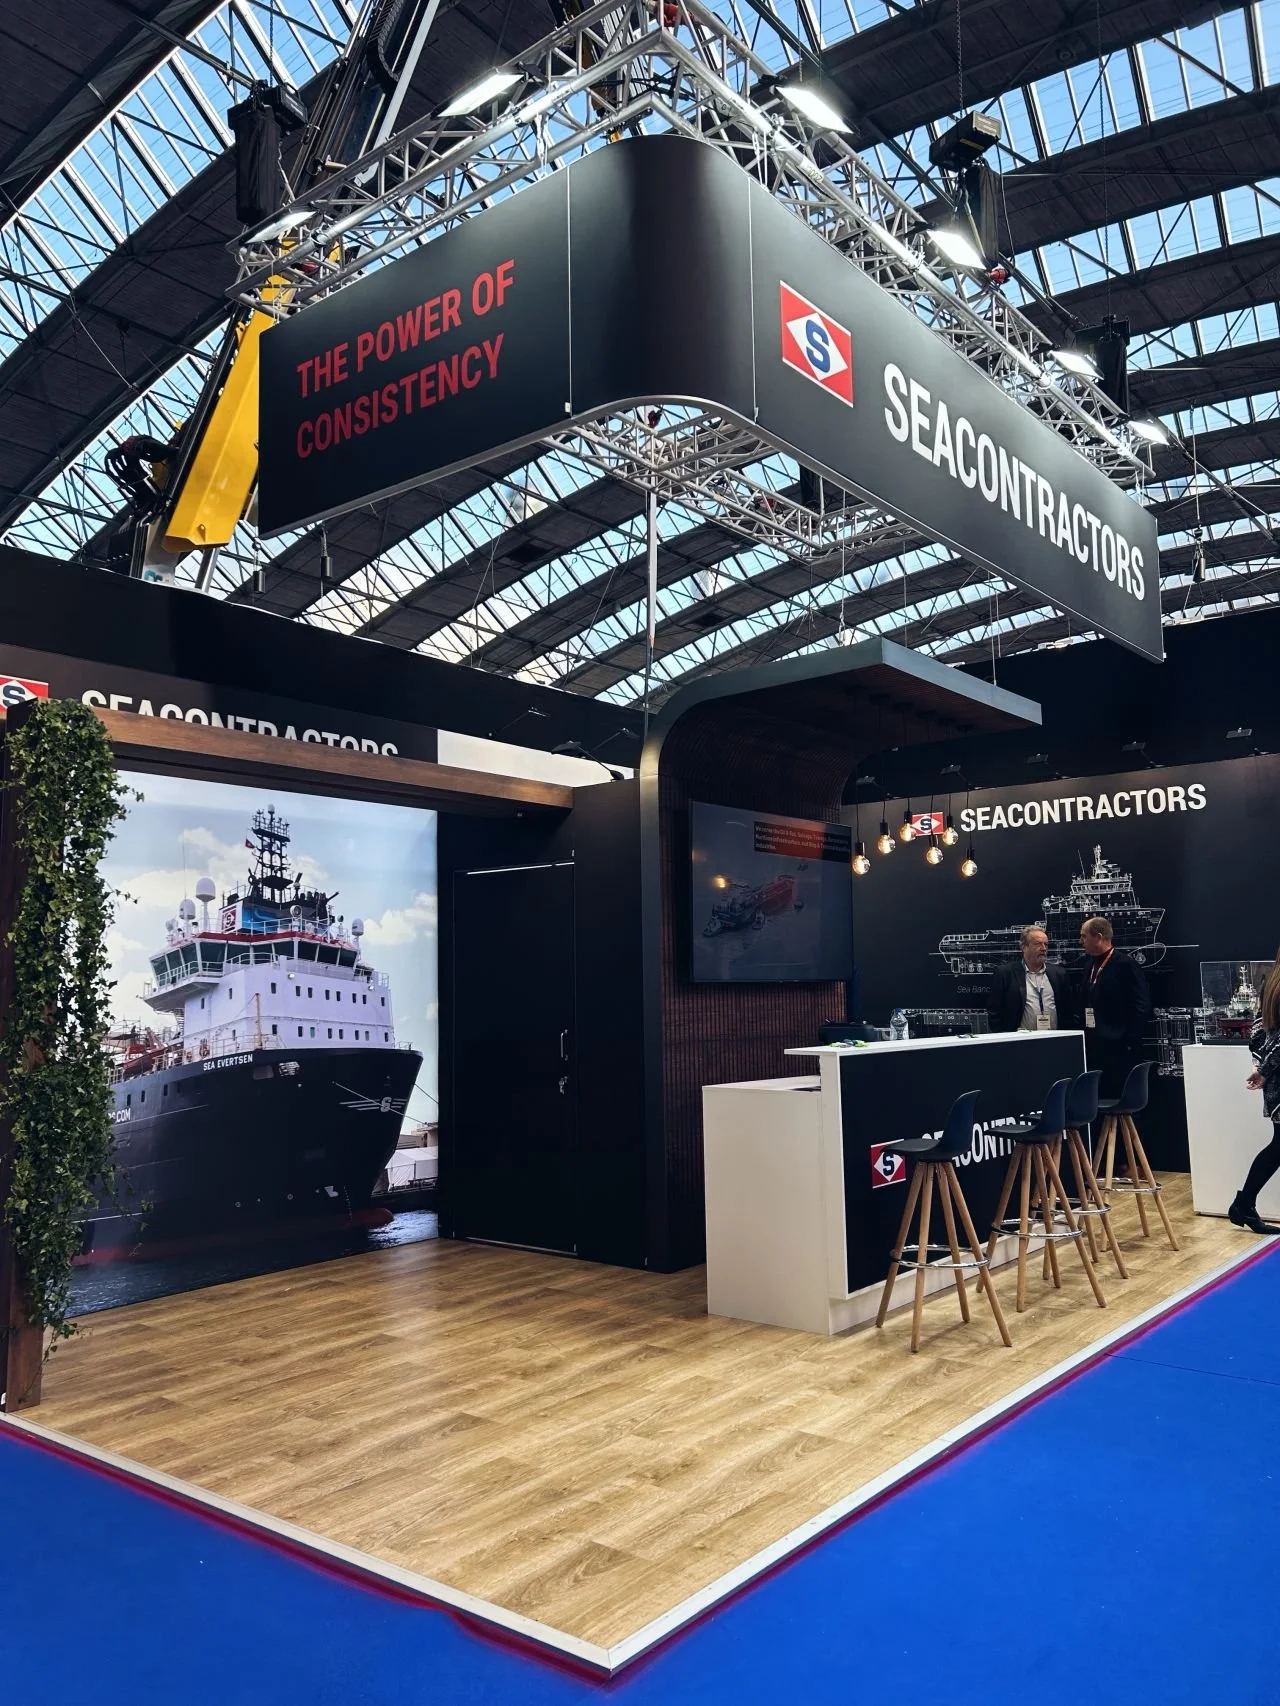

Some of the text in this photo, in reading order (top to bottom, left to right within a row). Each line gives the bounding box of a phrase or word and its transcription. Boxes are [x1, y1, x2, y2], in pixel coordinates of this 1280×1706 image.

[297, 258, 515, 398] THE POWER OF
[296, 333, 505, 458] CONSISTENCY
[882, 362, 1145, 602] SEACONTRACTORS
[960, 783, 1207, 832] SEACONTRACTORS
[203, 1053, 253, 1071] SEA EVERTSEN
